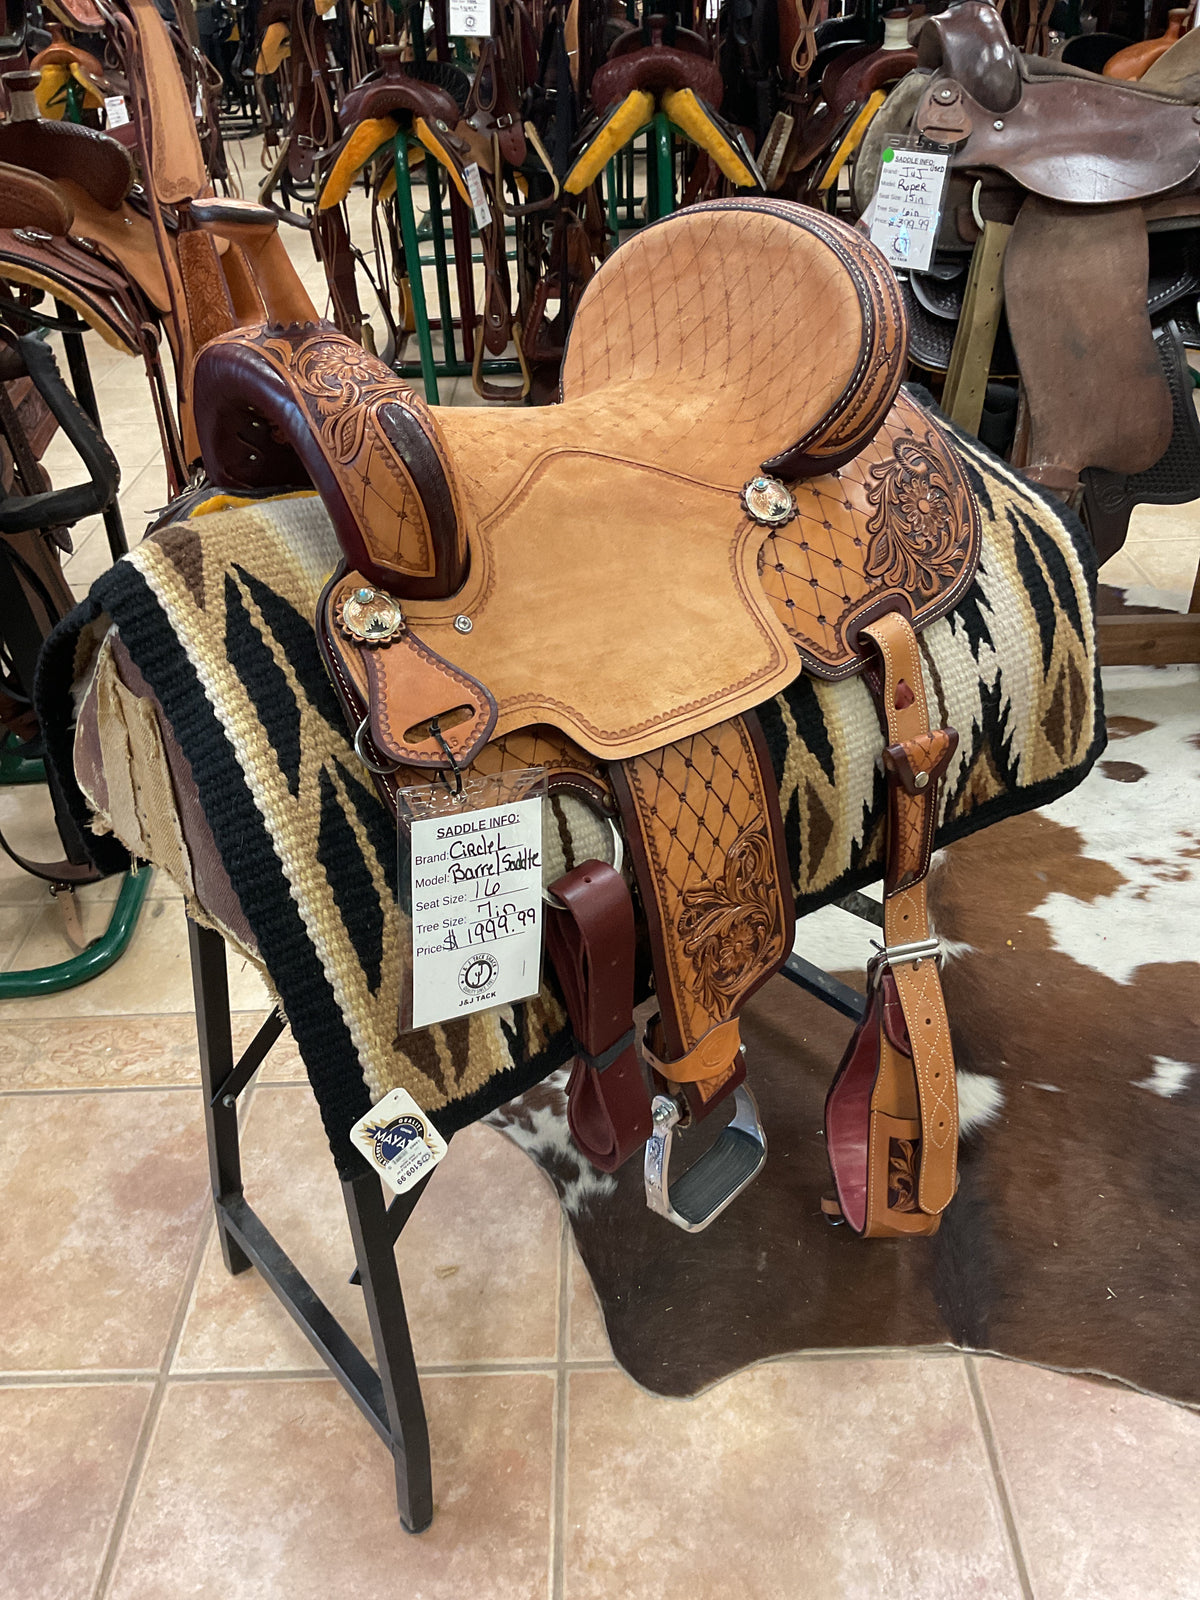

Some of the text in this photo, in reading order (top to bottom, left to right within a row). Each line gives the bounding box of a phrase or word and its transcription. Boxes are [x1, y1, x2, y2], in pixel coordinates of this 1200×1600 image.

[895, 156, 918, 164] SADDLE
[436, 813, 520, 839] SADDLE INFO:
[415, 851, 449, 866] Brand:
[415, 848, 541, 888] Model: Barrel Saddle
[416, 878, 501, 912] Seat Size: 16
[416, 922, 439, 934] Tree
[442, 916, 467, 929] Size:
[416, 944, 446, 957] Price:
[458, 991, 497, 1007] J&J TACK
[398, 1117, 423, 1131] QUALITY
[396, 1160, 423, 1185] $109.99
